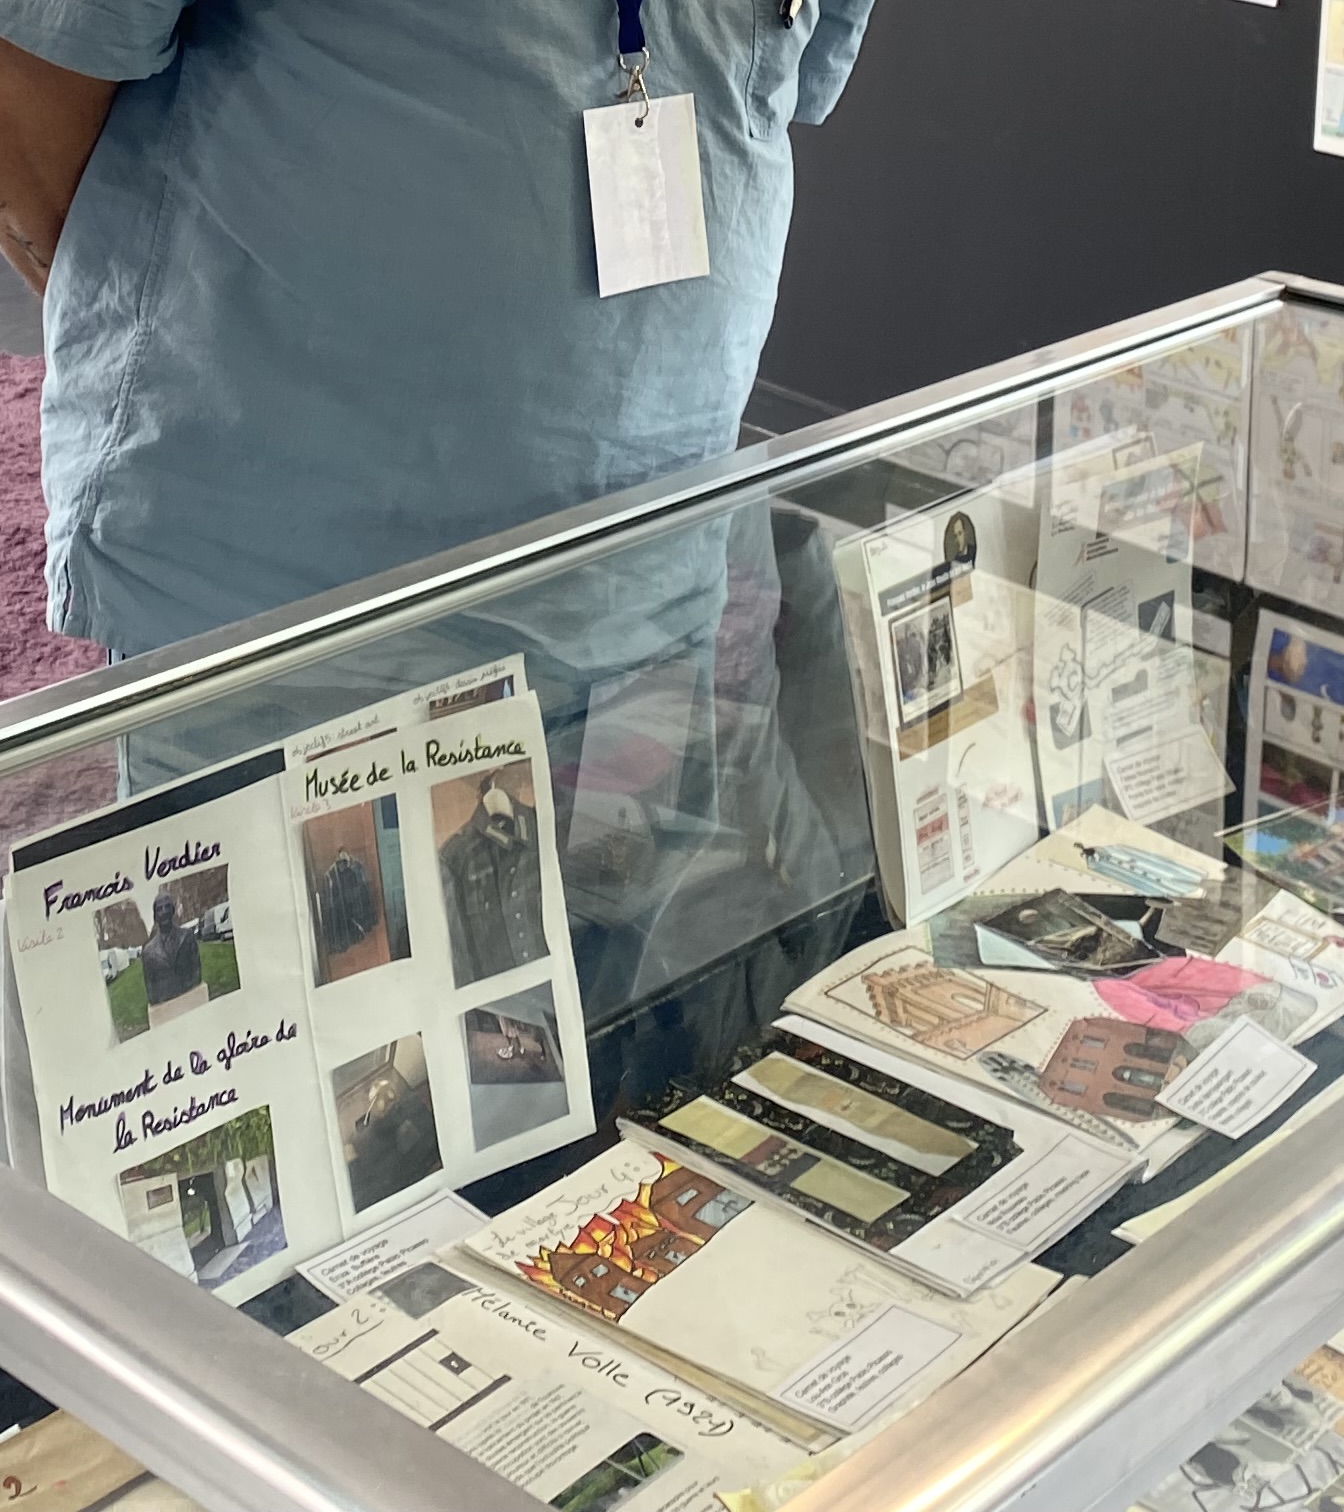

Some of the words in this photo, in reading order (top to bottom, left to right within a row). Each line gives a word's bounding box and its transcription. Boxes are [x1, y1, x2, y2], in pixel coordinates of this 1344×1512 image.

[305, 768, 365, 803] Musée
[366, 761, 393, 783] de
[401, 750, 418, 775] la
[426, 733, 527, 768] Resistance
[144, 840, 222, 882] Verdier
[58, 1069, 158, 1136] Monument
[162, 1060, 185, 1085] de
[189, 1051, 212, 1075] la
[275, 1018, 298, 1042] de
[113, 1112, 138, 1154] la
[141, 1086, 239, 1136] Resistance
[546, 1183, 610, 1216] Jour
[306, 1330, 349, 1356] our
[567, 1340, 629, 1388] Volle
